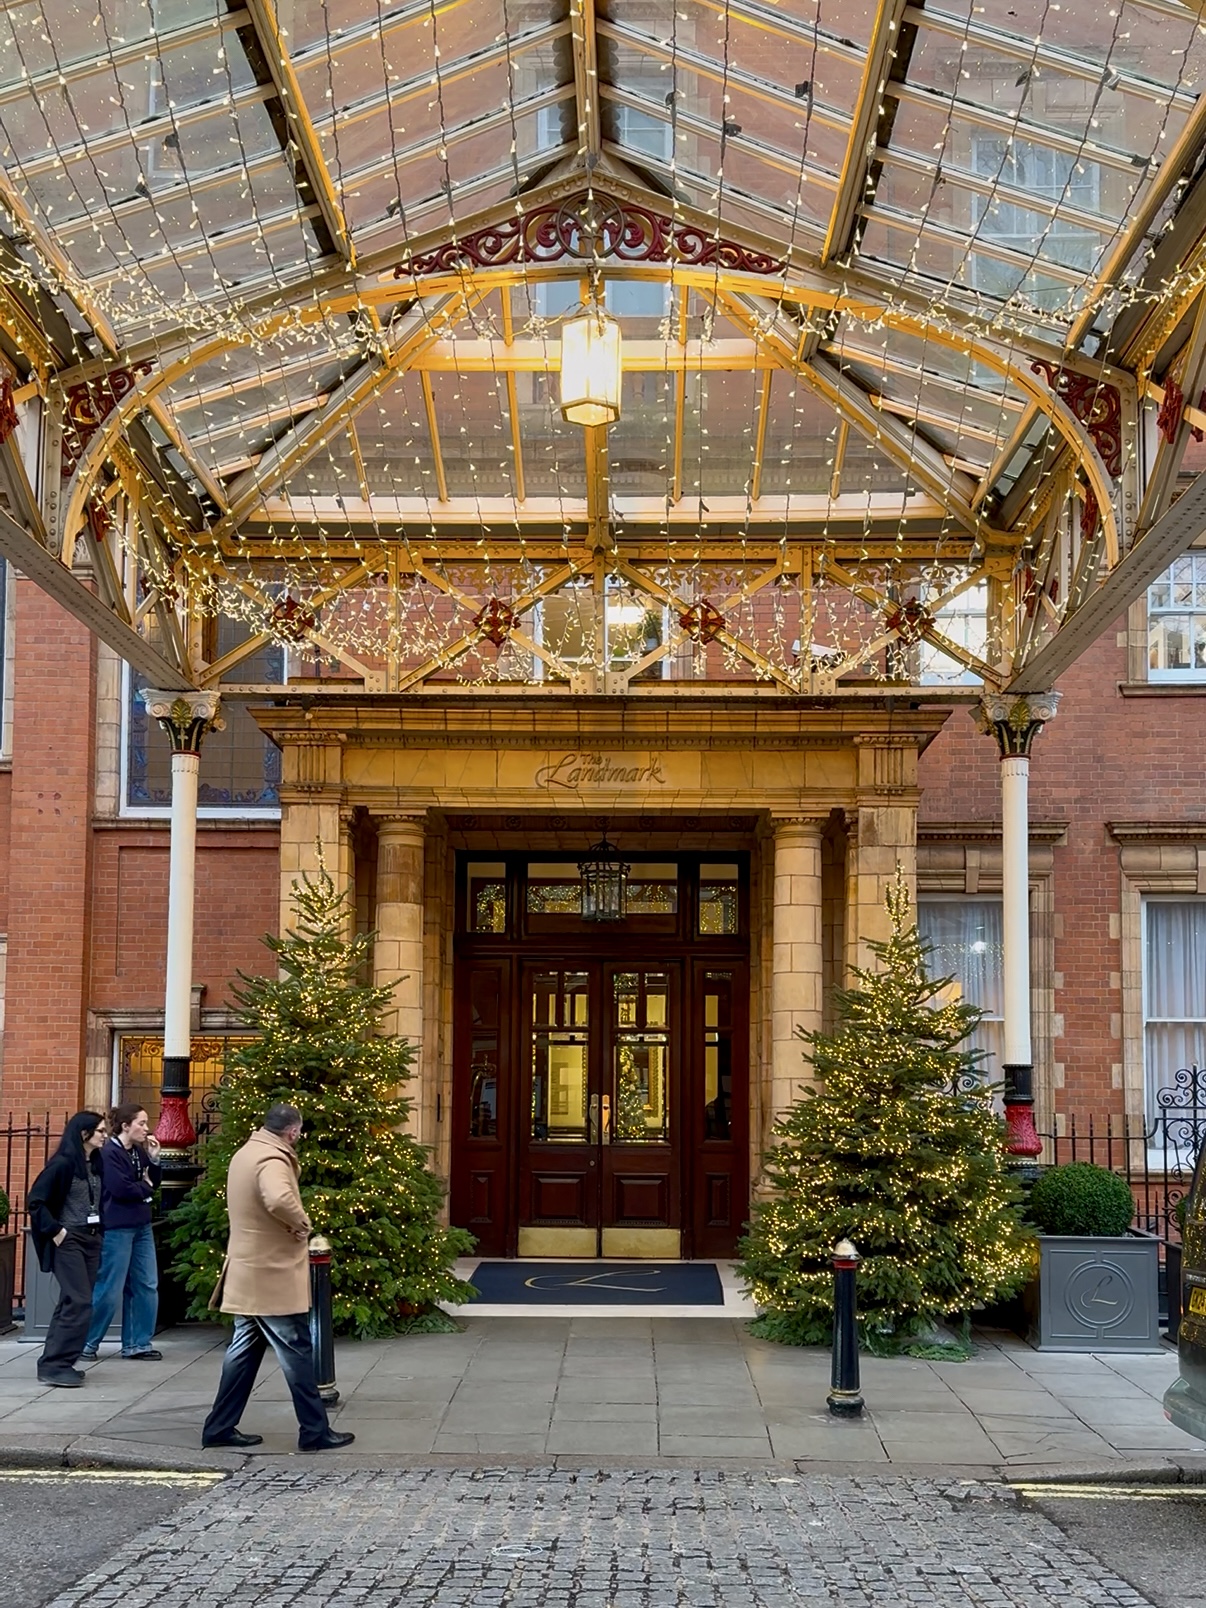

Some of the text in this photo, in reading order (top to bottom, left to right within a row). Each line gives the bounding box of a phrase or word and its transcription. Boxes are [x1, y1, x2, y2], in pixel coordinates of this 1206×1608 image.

[535, 753, 666, 789] Landmark
[580, 752, 603, 766] The
[524, 1269, 667, 1292] L
[1081, 1275, 1118, 1308] L
